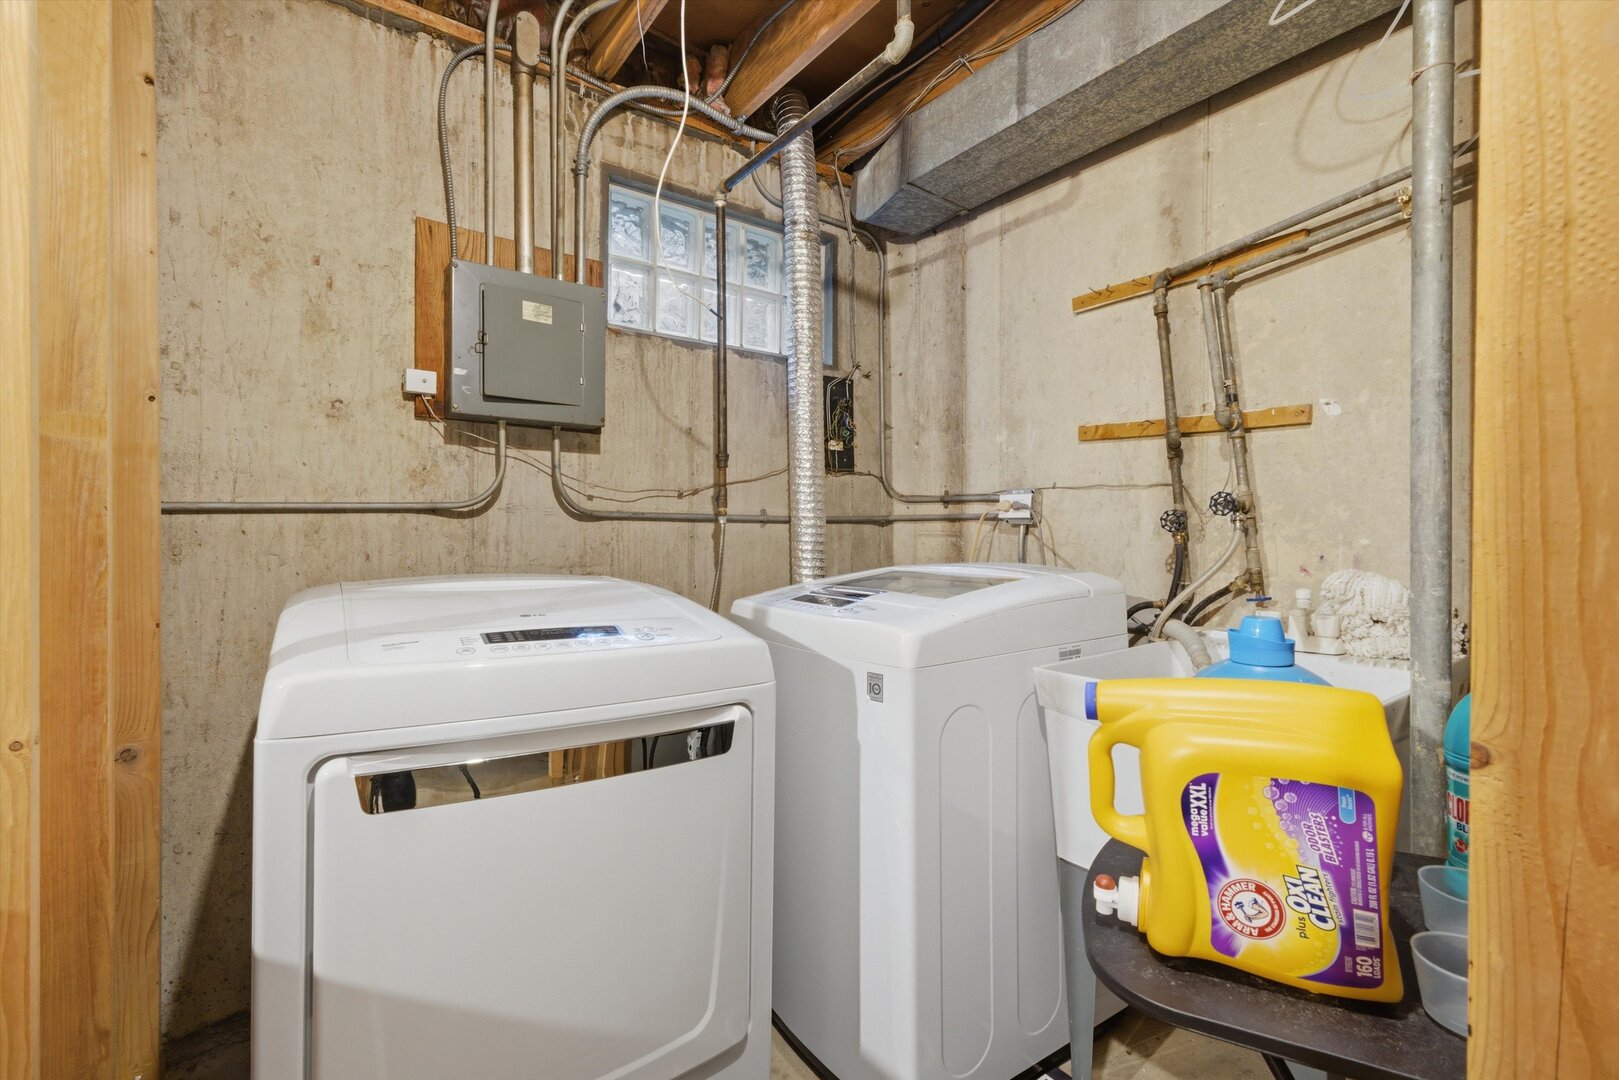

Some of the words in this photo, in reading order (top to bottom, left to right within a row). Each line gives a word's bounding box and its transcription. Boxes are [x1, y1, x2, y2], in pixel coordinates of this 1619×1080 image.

[1189, 783, 1208, 809] XXL
[1190, 808, 1200, 836] mega
[1199, 809, 1209, 837] value
[1302, 822, 1321, 852] ODOR
[1310, 813, 1338, 865] BLASTERS
[1221, 881, 1257, 910] HAMMER
[1283, 875, 1312, 914] OXI
[1296, 865, 1336, 931] CLEAN
[1322, 873, 1337, 903] fighters
[1224, 911, 1233, 922] &
[1296, 916, 1310, 939] plus
[1332, 904, 1344, 924] stain
[1231, 921, 1259, 937] ARM
[1355, 956, 1374, 977] 160
[1373, 958, 1381, 979] LOADS
